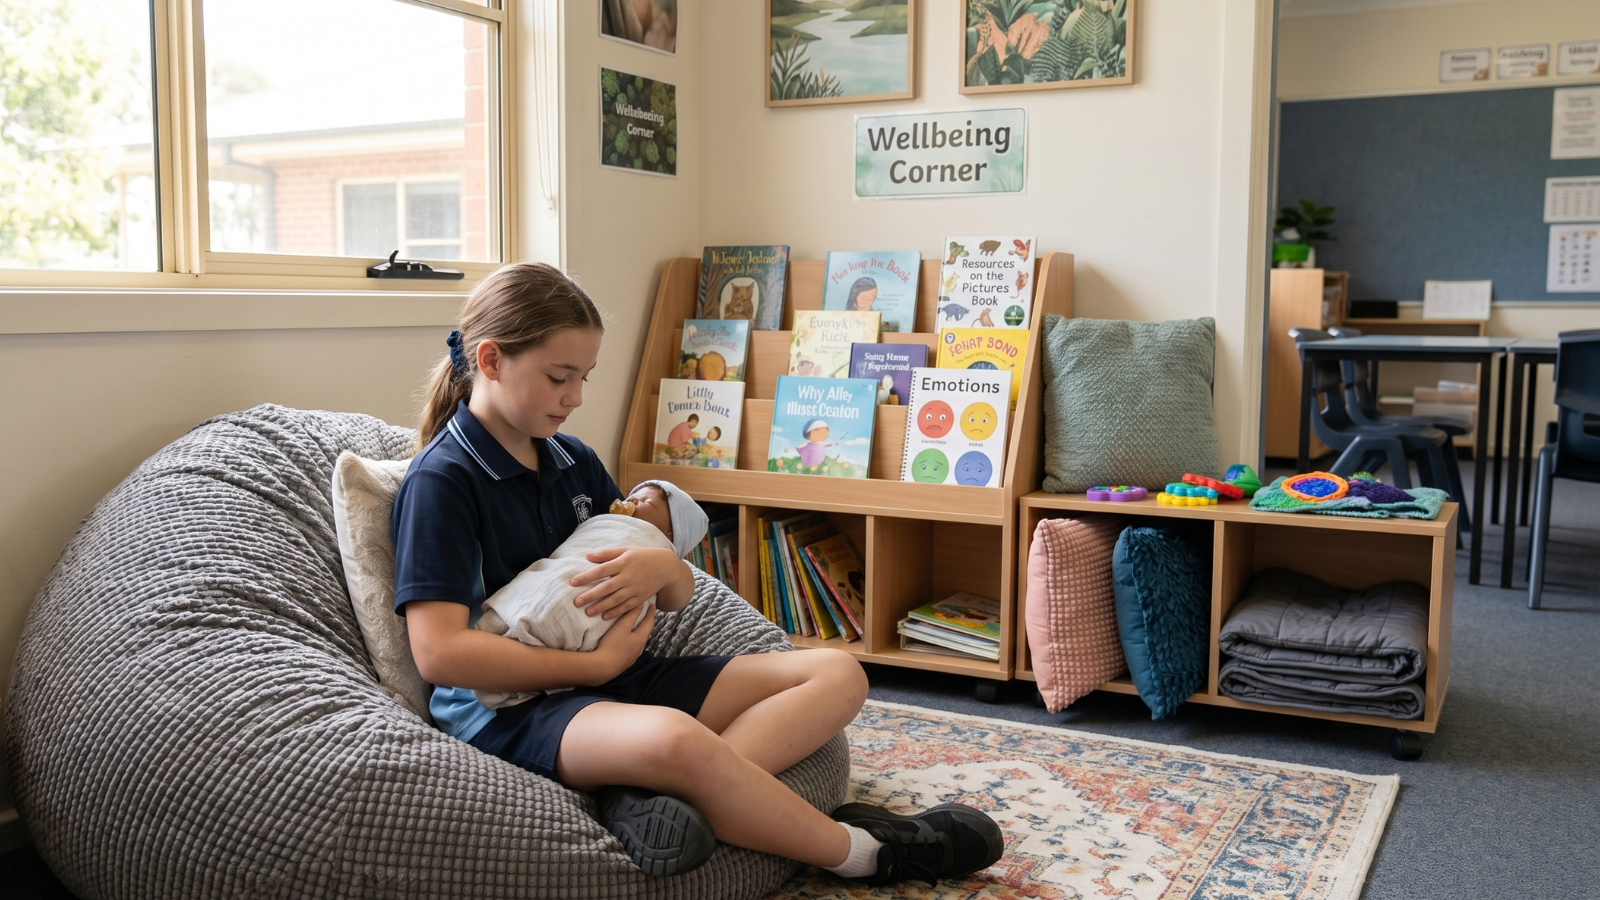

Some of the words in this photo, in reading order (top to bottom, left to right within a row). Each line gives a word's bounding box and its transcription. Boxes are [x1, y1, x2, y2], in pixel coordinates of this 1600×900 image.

[626, 123, 655, 139] Corner
[867, 119, 1011, 154] Wellbeing
[889, 159, 988, 184] Corner
[886, 259, 911, 284] Book
[962, 259, 1015, 269] Resources
[969, 272, 983, 281] on
[986, 271, 1004, 281] the
[962, 282, 1010, 293] Pictures
[971, 295, 999, 306] Book
[921, 377, 1000, 394] Emotions
[797, 384, 825, 404] Why
[826, 386, 853, 403] Alley
